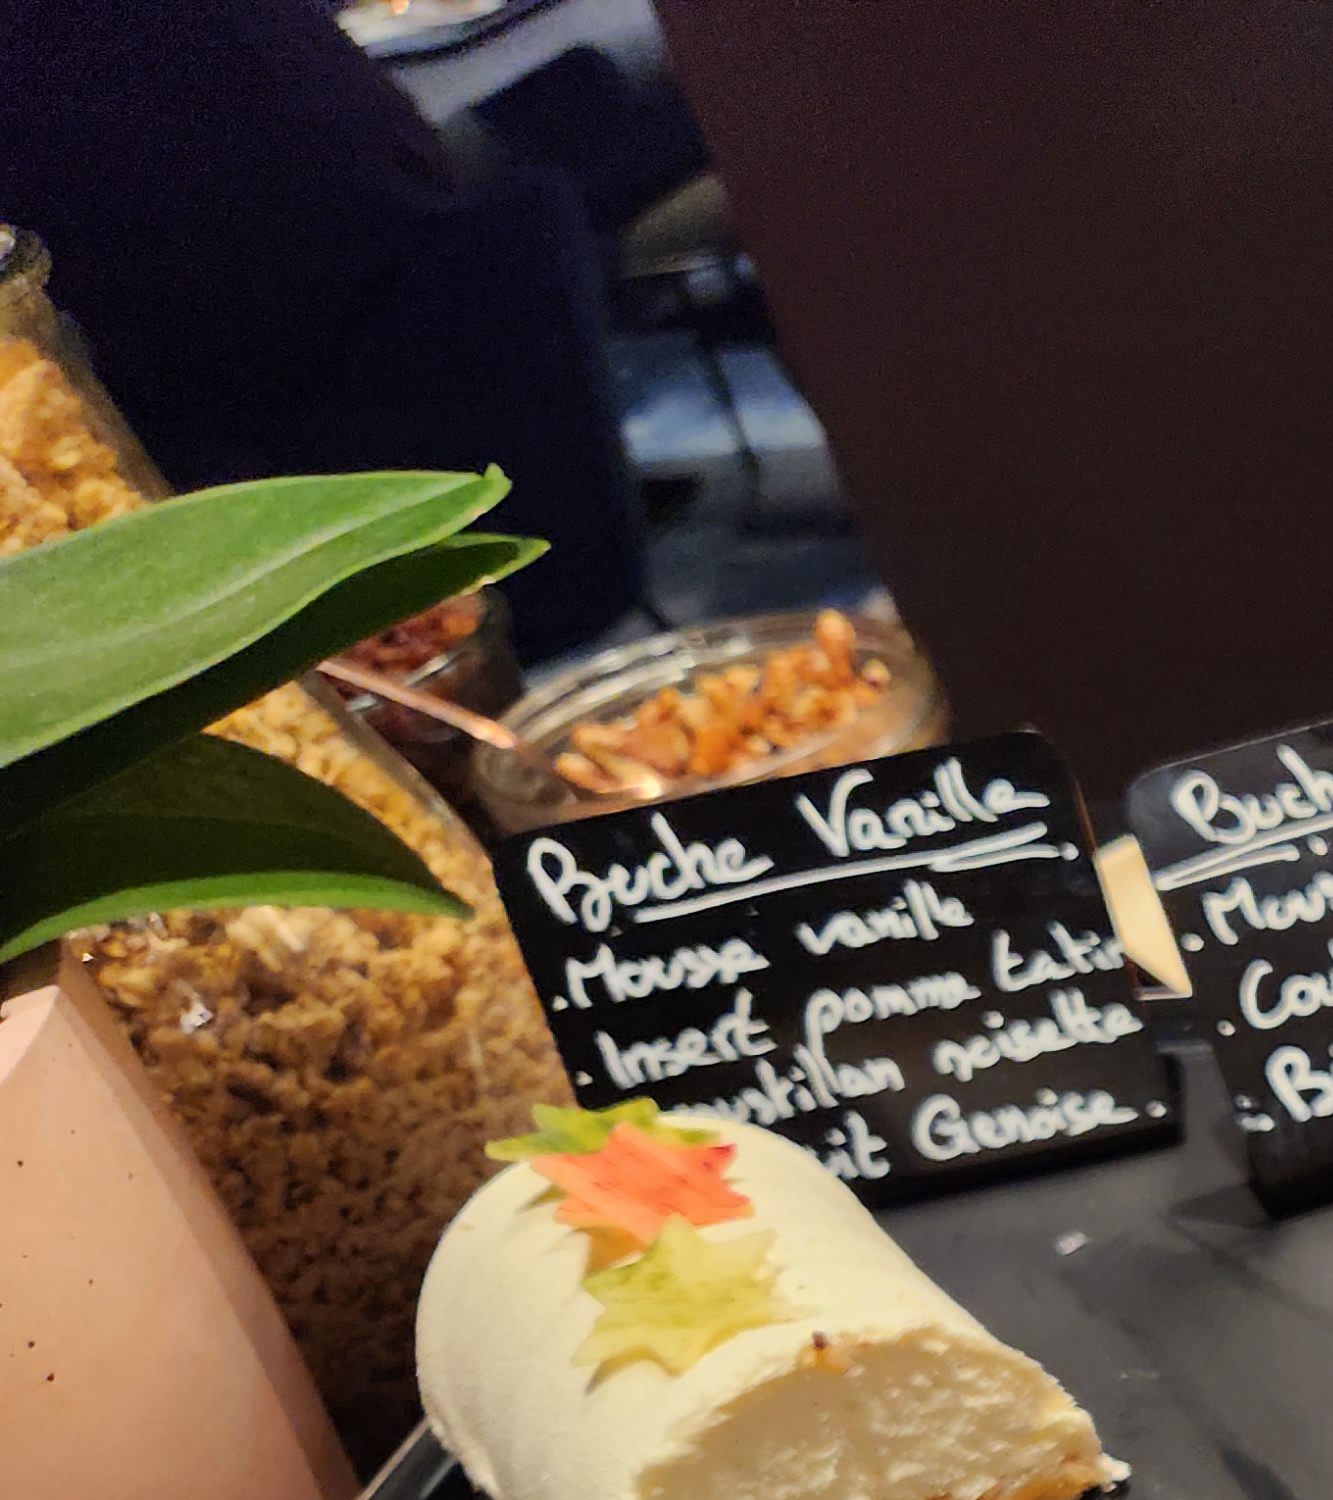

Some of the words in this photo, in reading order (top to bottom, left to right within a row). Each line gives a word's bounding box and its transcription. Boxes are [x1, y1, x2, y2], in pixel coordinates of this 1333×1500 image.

[797, 757, 1050, 856] Vanille
[797, 880, 975, 955] vanille
[595, 987, 777, 1090] Insert
